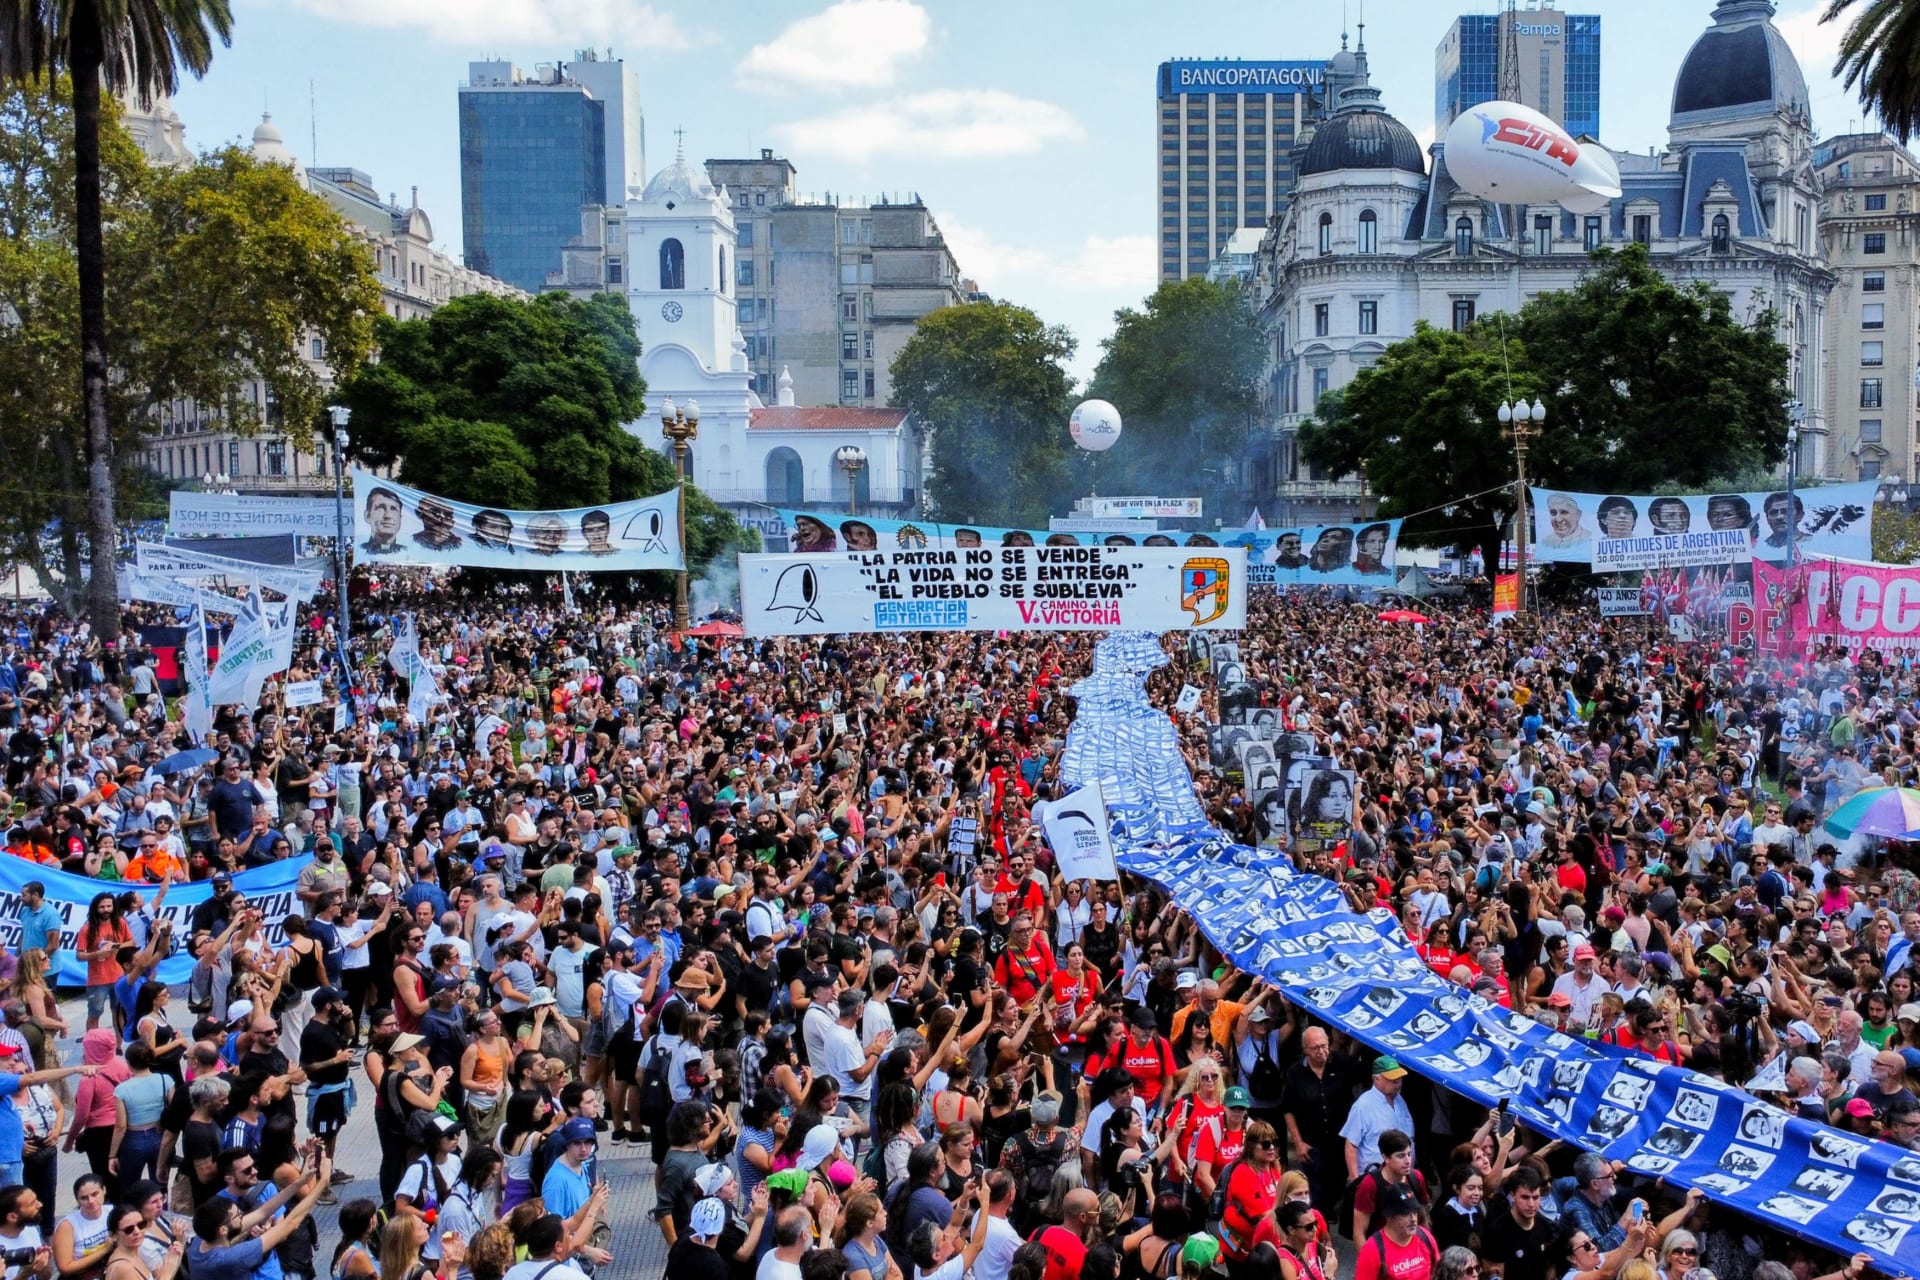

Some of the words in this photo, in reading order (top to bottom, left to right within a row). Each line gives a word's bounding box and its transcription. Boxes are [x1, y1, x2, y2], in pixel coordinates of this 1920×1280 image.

[1515, 22, 1560, 37] Pampa
[1129, 499, 1143, 507] VIVE
[1596, 536, 1662, 556] JUVENTUDES
[1664, 535, 1679, 550] DE
[1682, 530, 1745, 549] ARGENTINA
[892, 551, 957, 565] PATRIA
[966, 550, 993, 564] NO
[1001, 549, 1025, 564] SE
[1627, 552, 1656, 562] razones
[1677, 548, 1710, 558] defender
[1712, 547, 1719, 555] la
[1721, 545, 1747, 554] Patria
[149, 563, 173, 571] PARA
[909, 567, 955, 582] VIDA
[966, 567, 994, 581] NO
[1001, 566, 1027, 581] SE
[912, 583, 989, 599] PUEBLO
[1000, 583, 1024, 598] SE
[1601, 591, 1612, 601] 40
[1725, 586, 1750, 597] CRACIA
[1040, 600, 1087, 609] CAMINO
[1105, 600, 1119, 609] LA
[1041, 609, 1121, 625] VICTORIA
